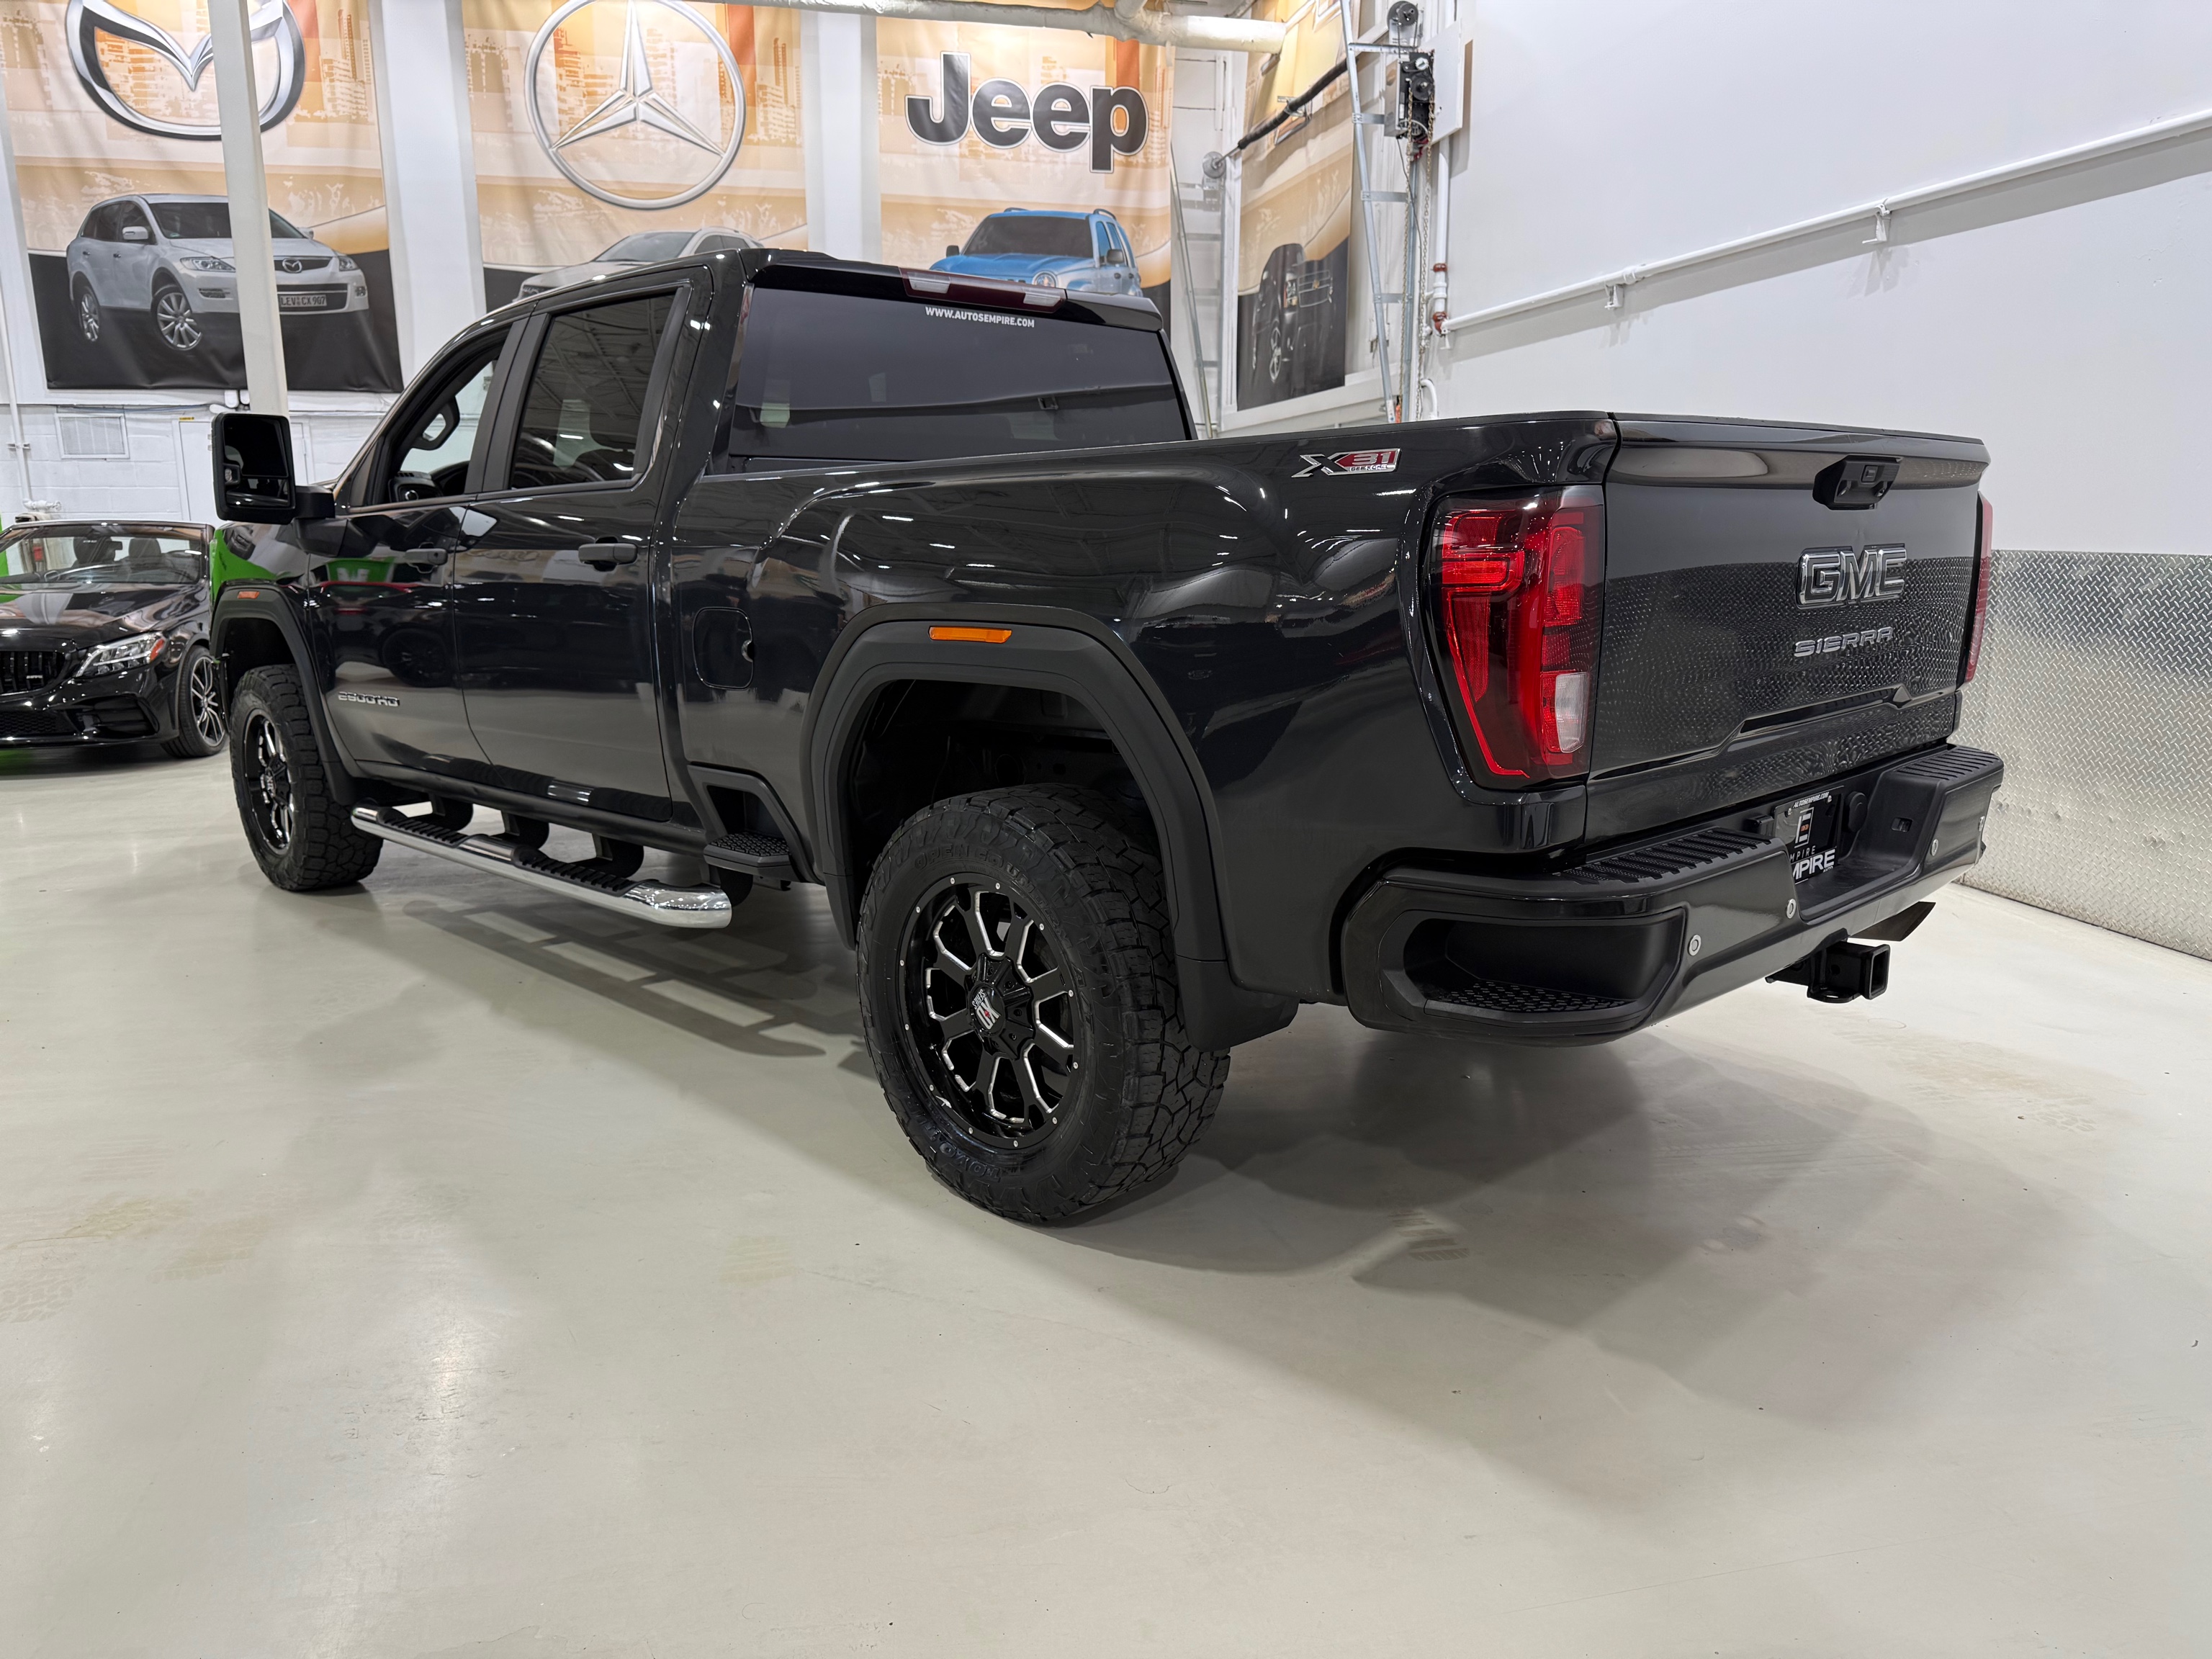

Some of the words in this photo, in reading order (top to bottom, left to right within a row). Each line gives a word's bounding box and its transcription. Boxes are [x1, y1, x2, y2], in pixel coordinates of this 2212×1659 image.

[904, 51, 1149, 173] Jeep
[280, 296, 296, 306] LEV
[925, 306, 1035, 328] WWW.AUTOSEMPIRE.COM
[1291, 448, 1401, 478] X31
[1798, 545, 1907, 606] GMC
[1794, 626, 1894, 657] SIERRA
[914, 842, 969, 870] OPEN
[1789, 845, 1816, 863] MPIRE
[1792, 848, 1835, 880] MPIRE
